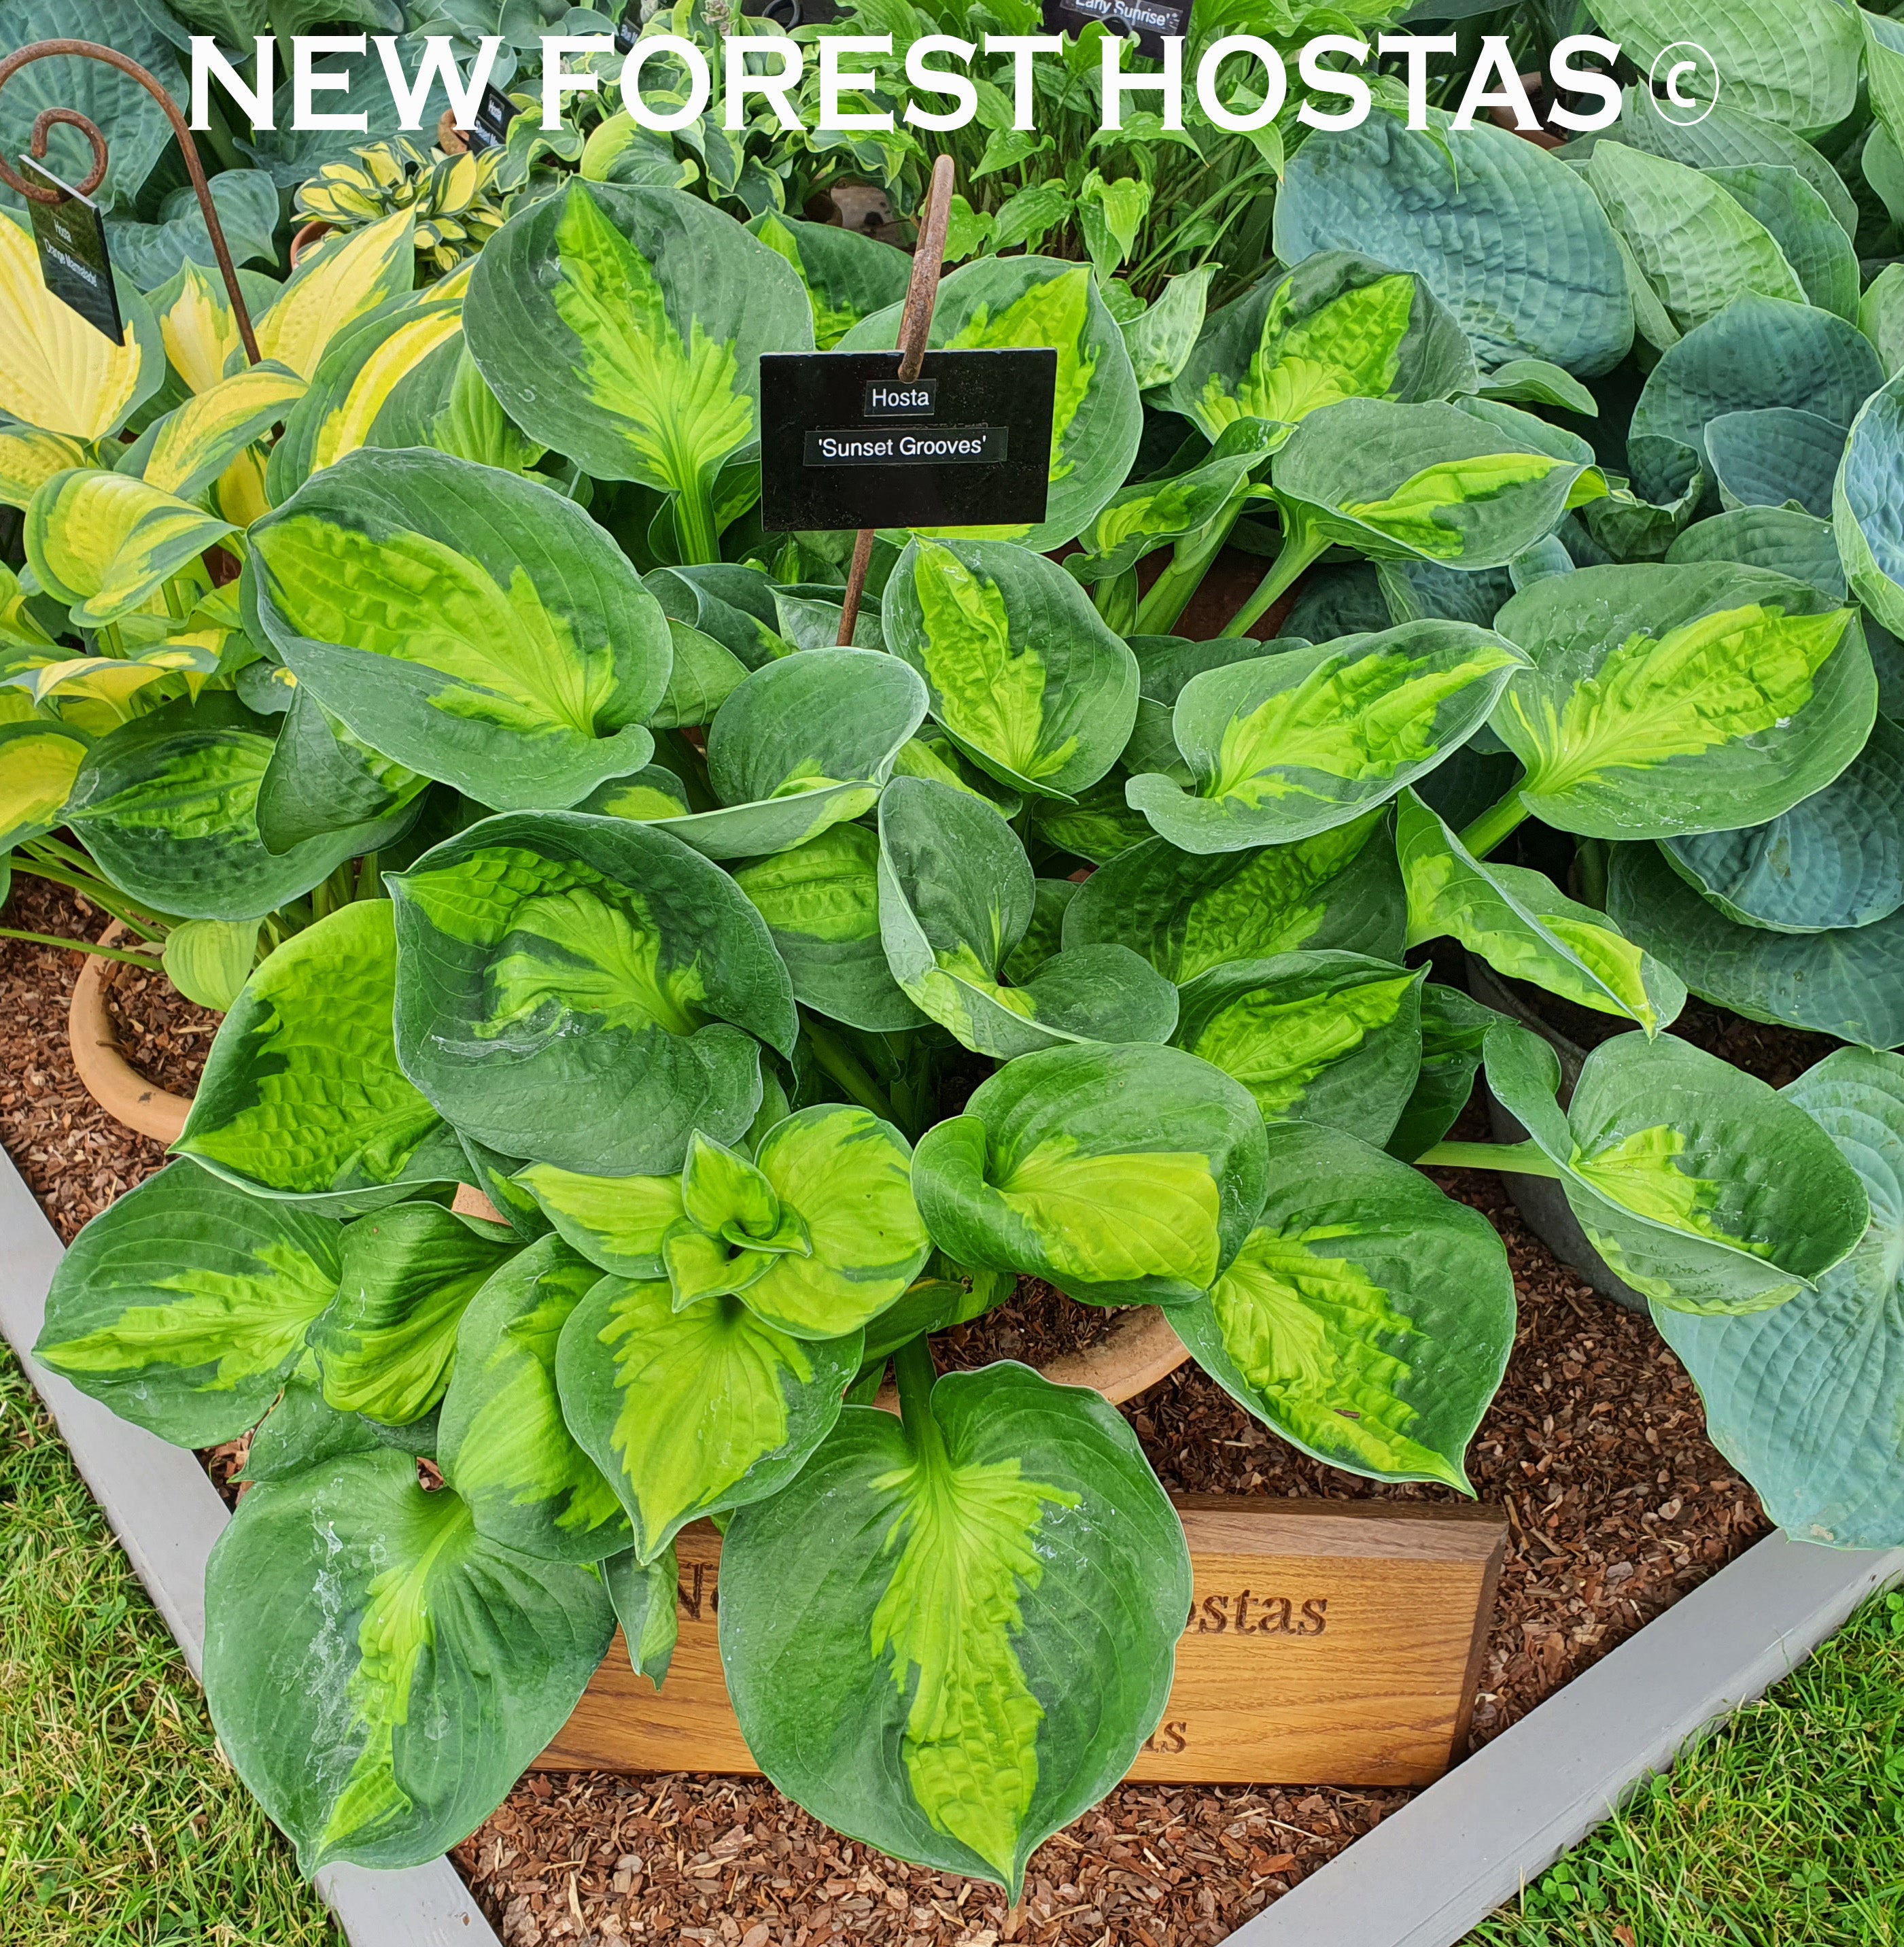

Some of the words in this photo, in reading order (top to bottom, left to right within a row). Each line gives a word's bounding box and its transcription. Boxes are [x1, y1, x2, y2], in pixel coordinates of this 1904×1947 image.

[872, 388, 930, 407] Hosta
[818, 437, 894, 458] 'Sunset
[899, 435, 987, 456] Grooves'
